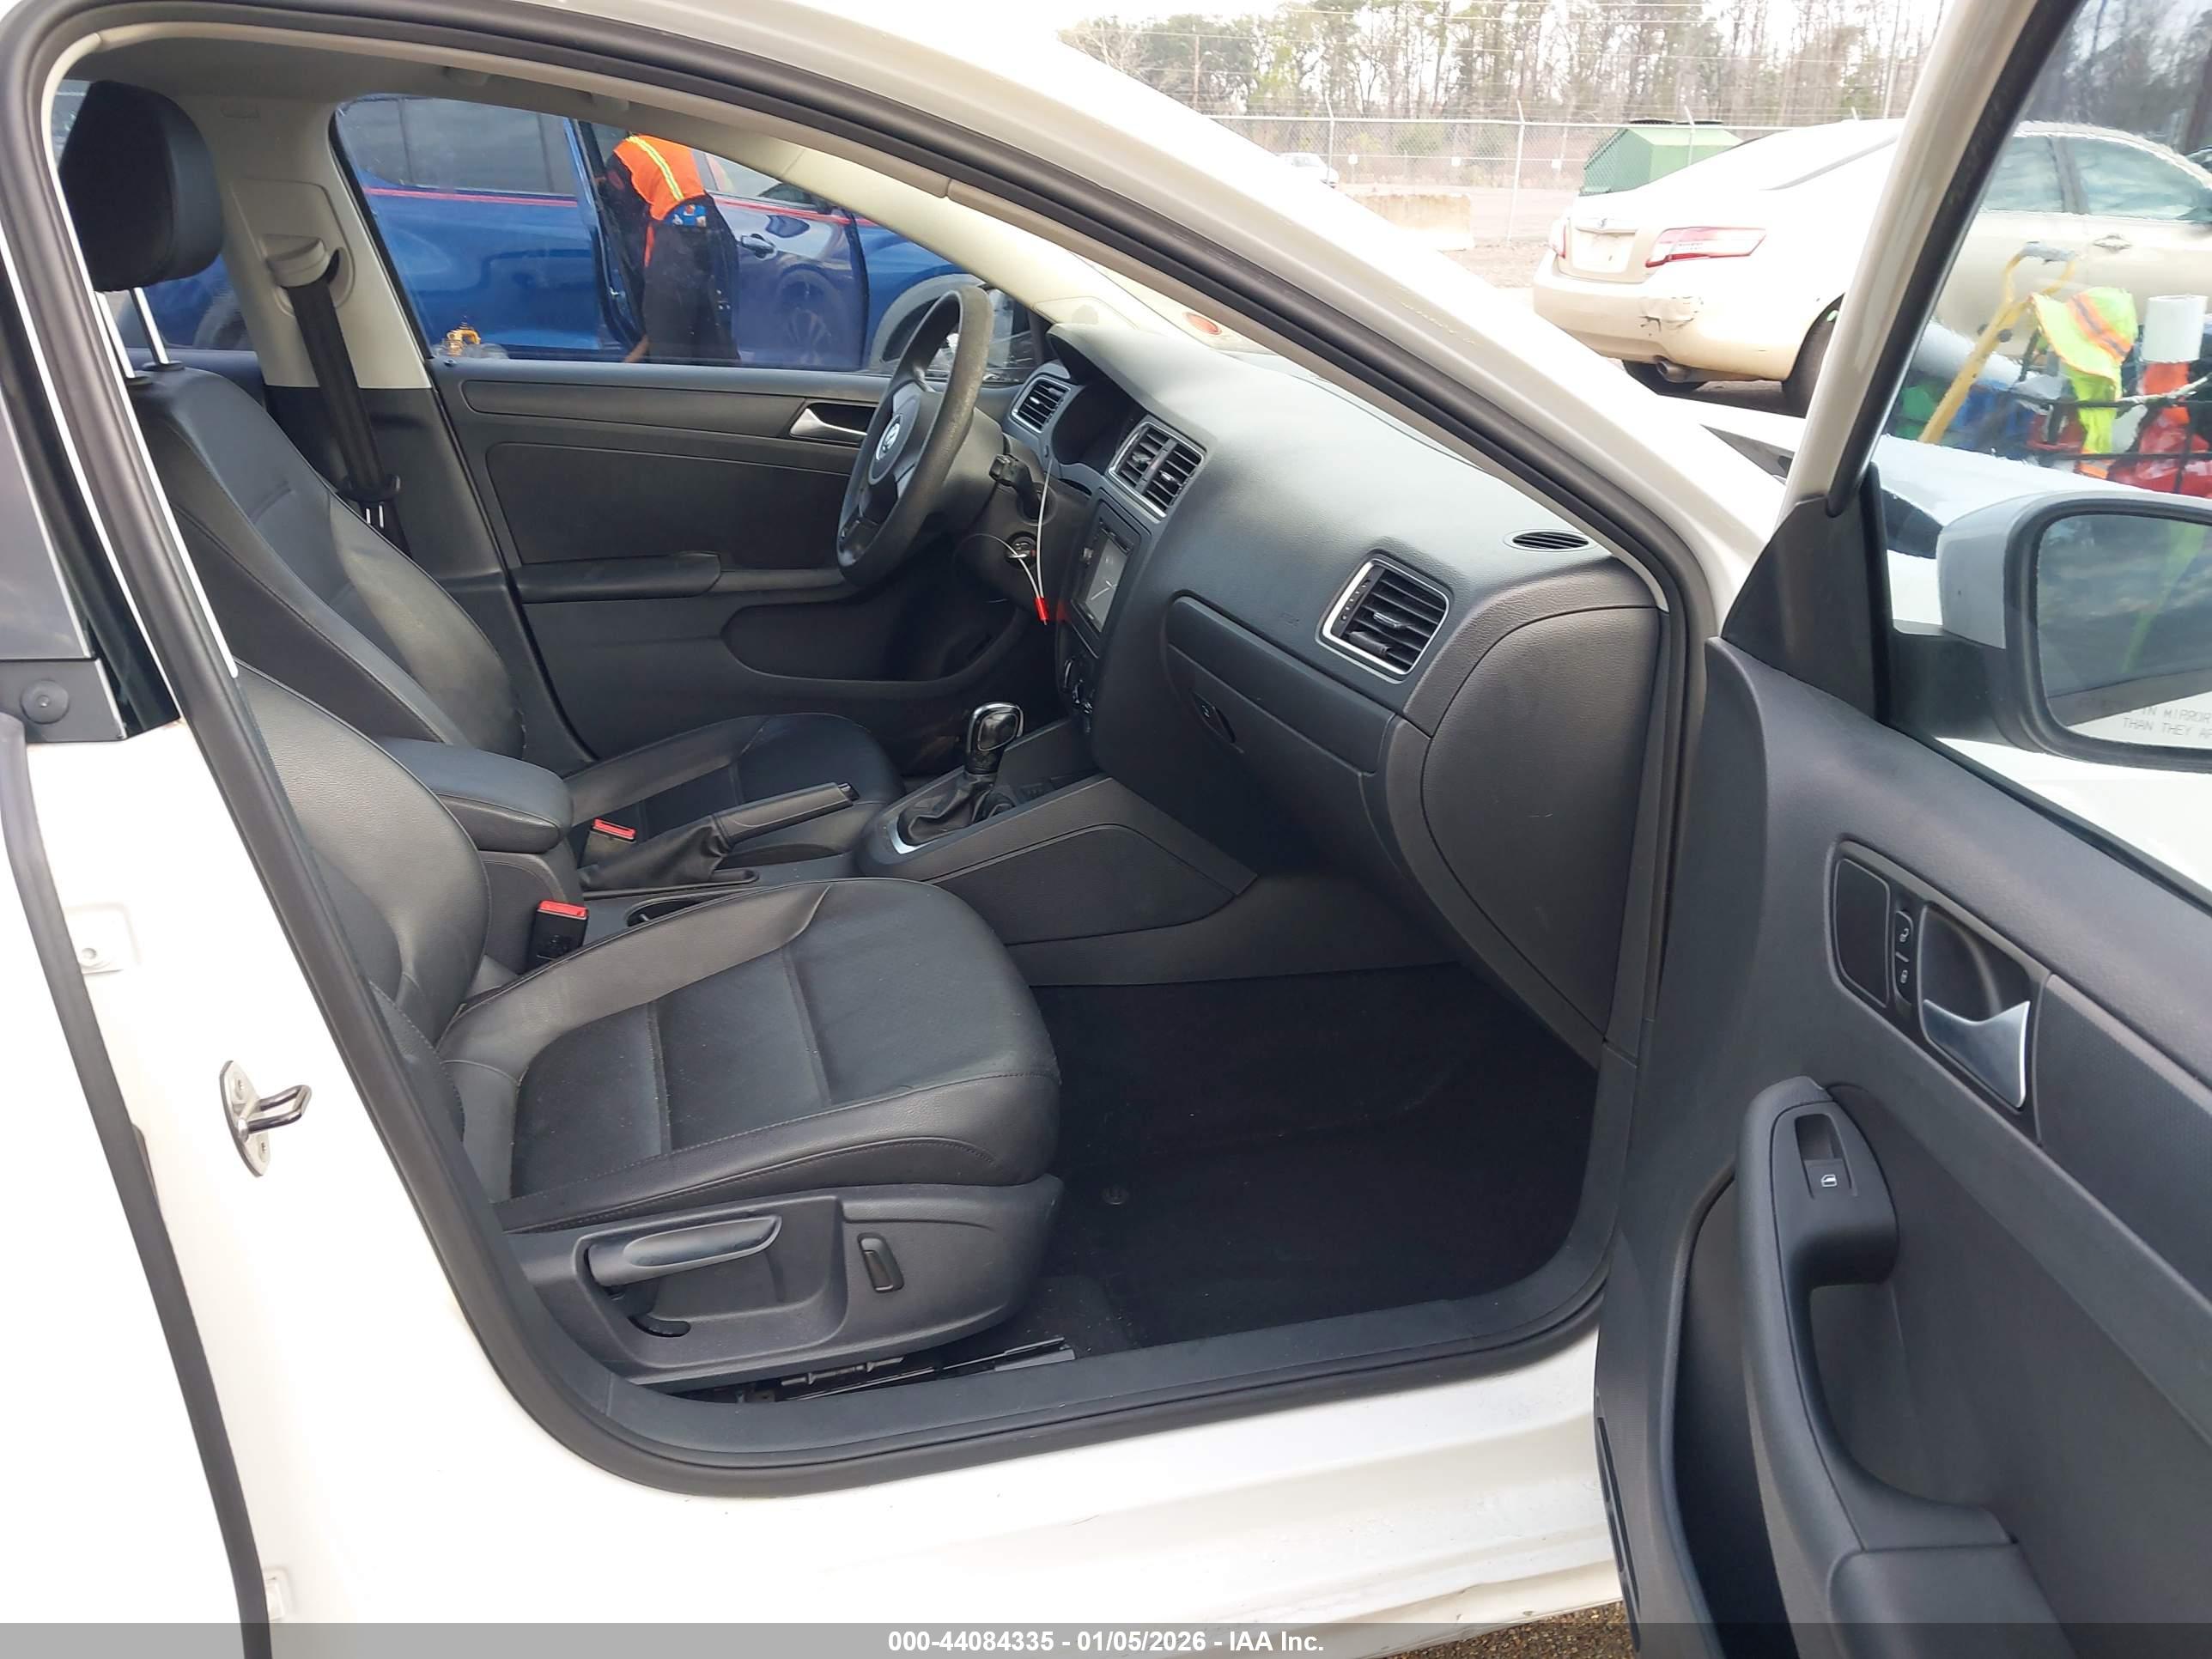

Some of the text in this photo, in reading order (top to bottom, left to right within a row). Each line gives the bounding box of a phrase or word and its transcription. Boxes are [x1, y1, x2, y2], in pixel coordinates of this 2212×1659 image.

[2142, 706, 2157, 716] IN
[2123, 716, 2154, 732] THAN
[2162, 721, 2192, 737] THEY
